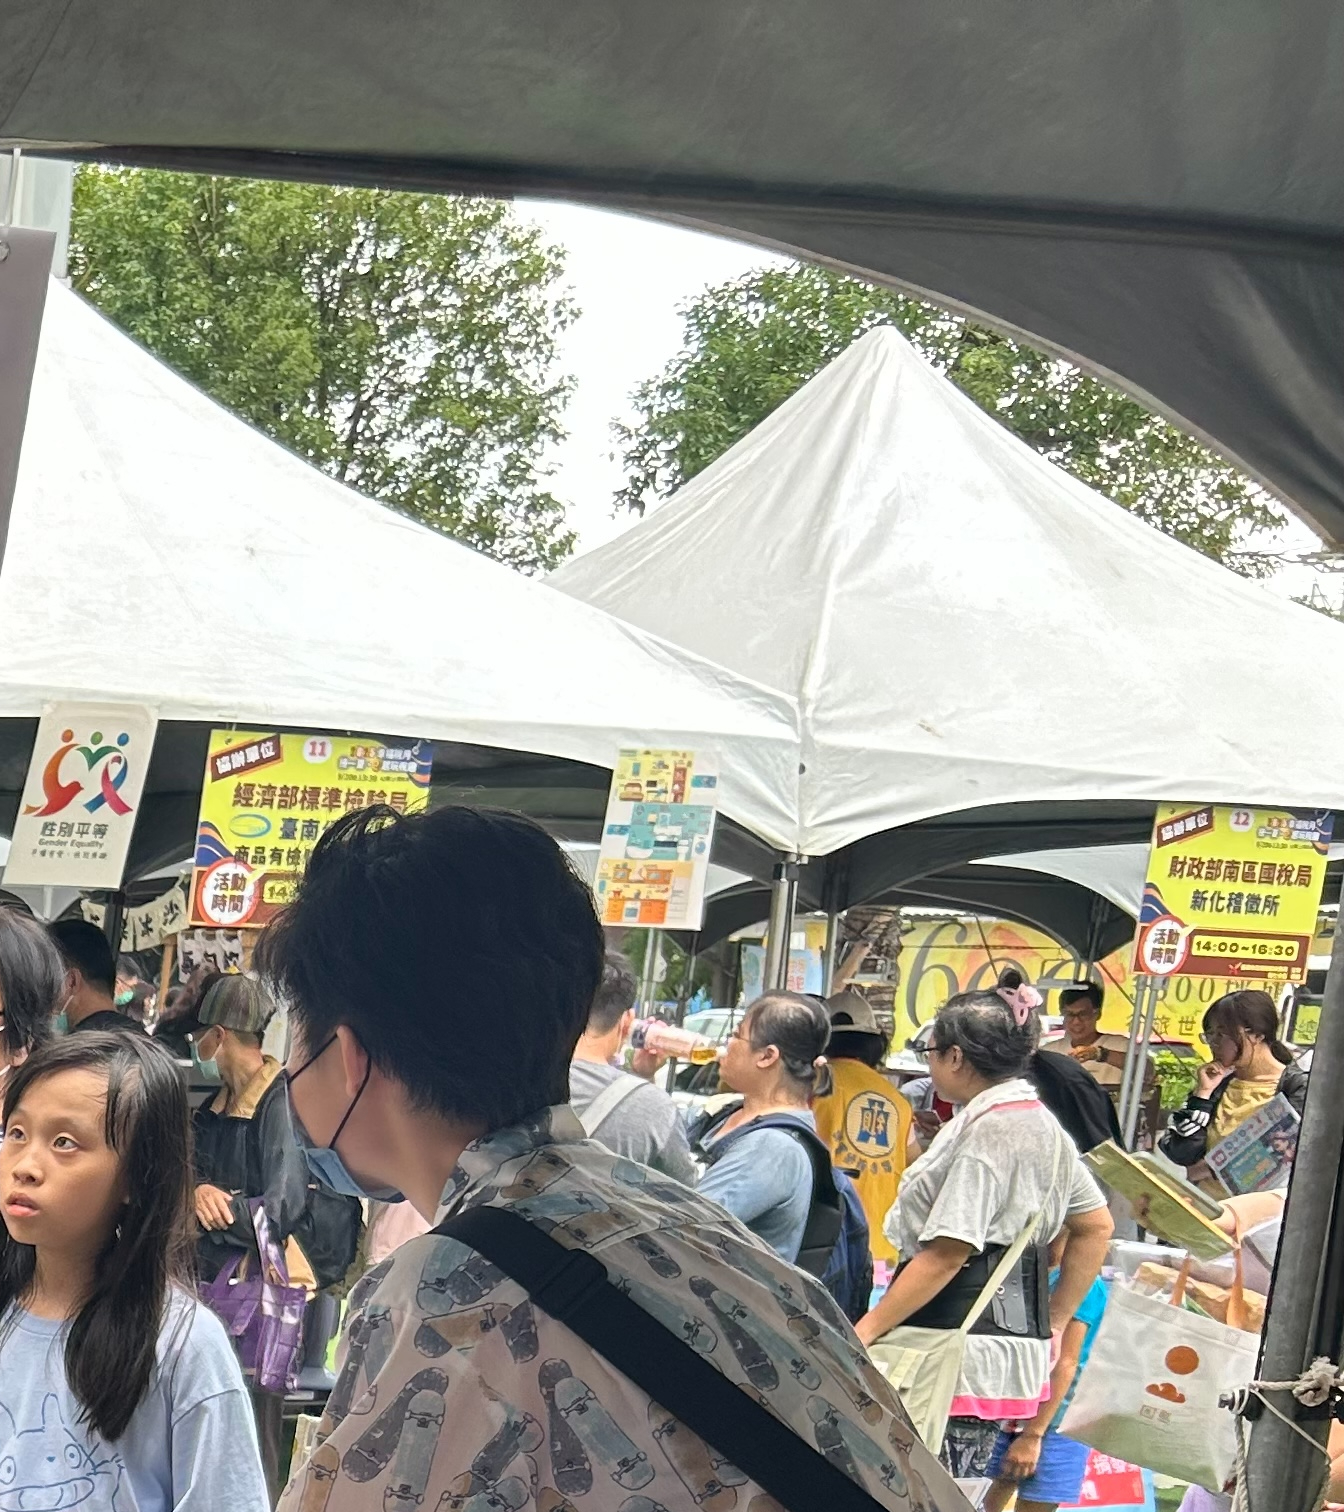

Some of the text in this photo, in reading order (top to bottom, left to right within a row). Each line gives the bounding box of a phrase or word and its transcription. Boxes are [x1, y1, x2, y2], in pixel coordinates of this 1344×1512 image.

[309, 741, 327, 757] 11
[1233, 812, 1250, 826] 12
[40, 821, 109, 839] 性別平等
[278, 817, 330, 840] 臺南
[38, 838, 104, 849] Gender Equality
[1168, 856, 1312, 889] 財政部南區國稅局
[214, 872, 247, 892] 活動
[211, 894, 244, 913] 時間
[1190, 889, 1281, 917] 新化稽徵所
[1153, 929, 1180, 946] 活動
[1150, 948, 1177, 965] 時間
